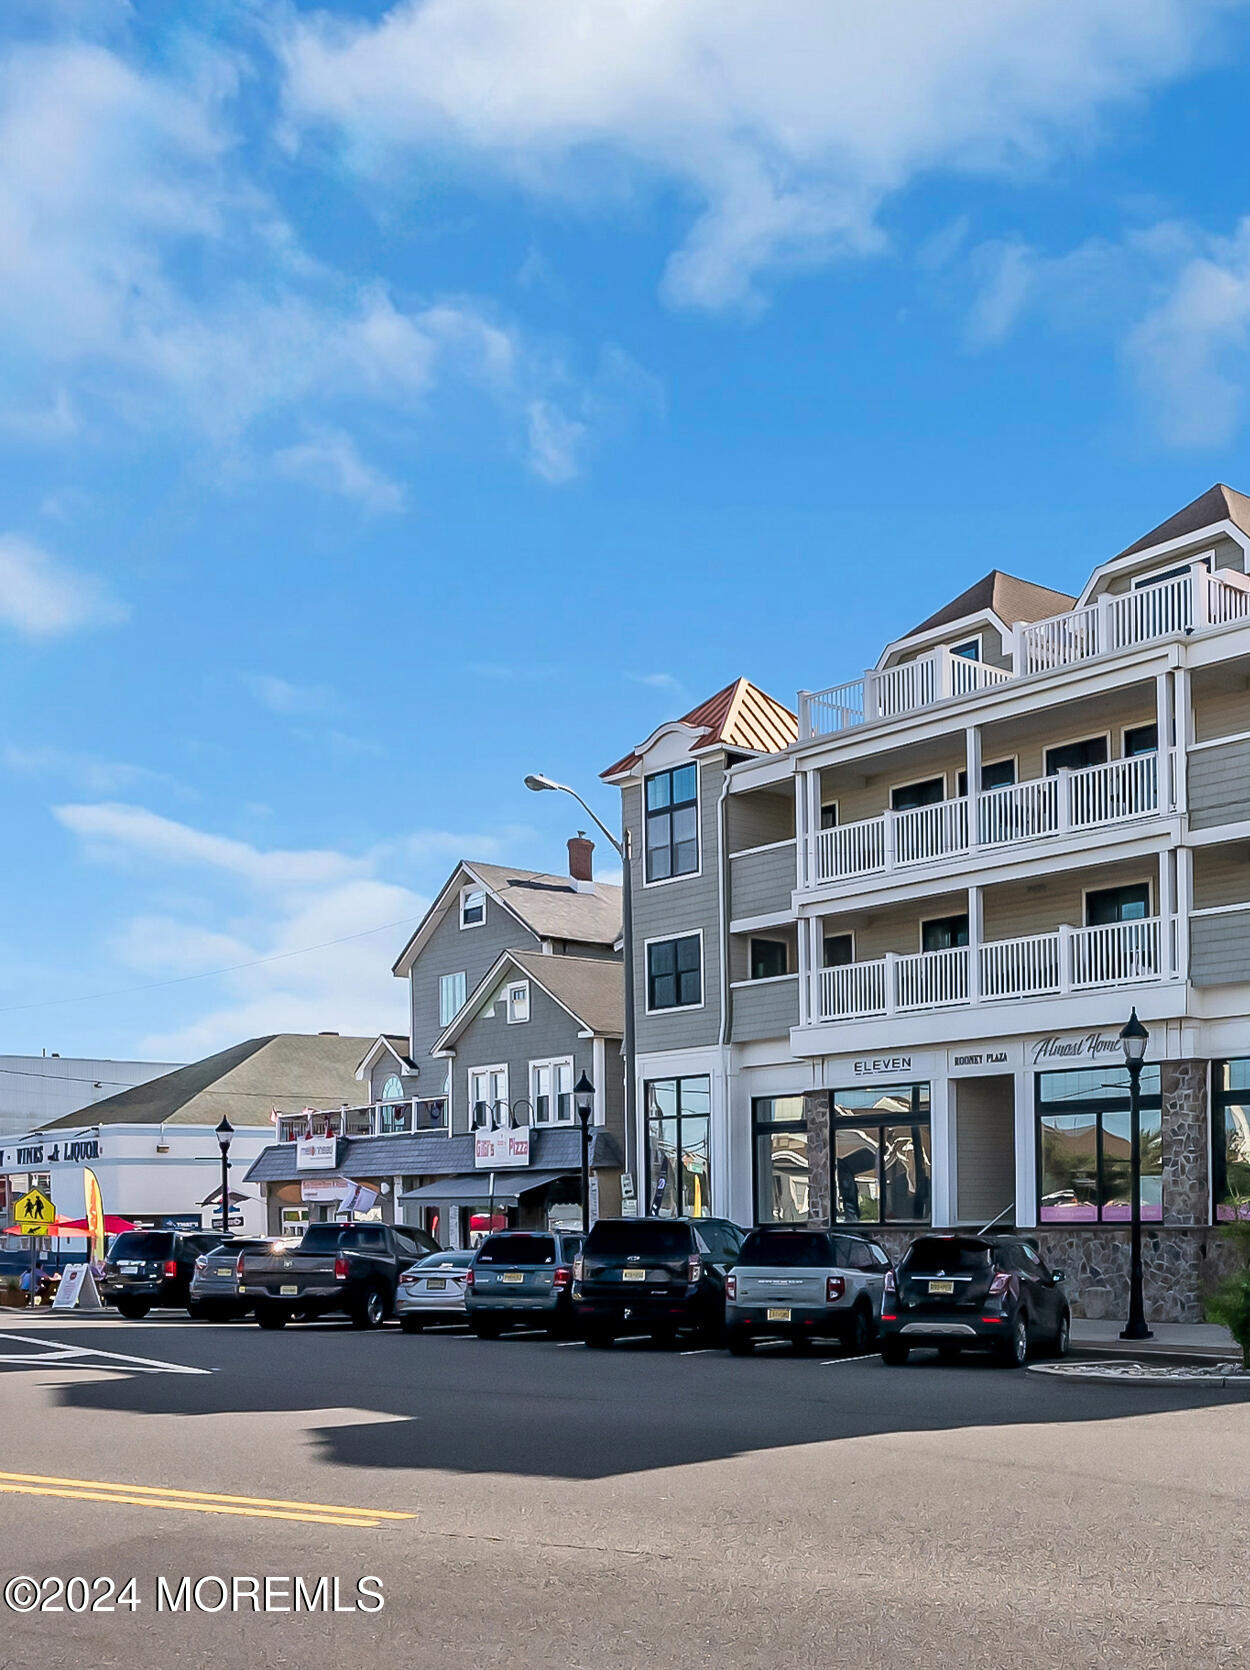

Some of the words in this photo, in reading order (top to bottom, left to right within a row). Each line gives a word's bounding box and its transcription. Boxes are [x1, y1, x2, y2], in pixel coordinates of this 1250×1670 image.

[1031, 1036, 1083, 1065] Almost
[1085, 1032, 1121, 1059] Home
[854, 1056, 911, 1072] ELEVEN
[954, 1054, 983, 1066] ROONEY
[986, 1052, 1008, 1063] PLAZA
[17, 1145, 44, 1165] WINES
[64, 1140, 99, 1163] LIQUOR
